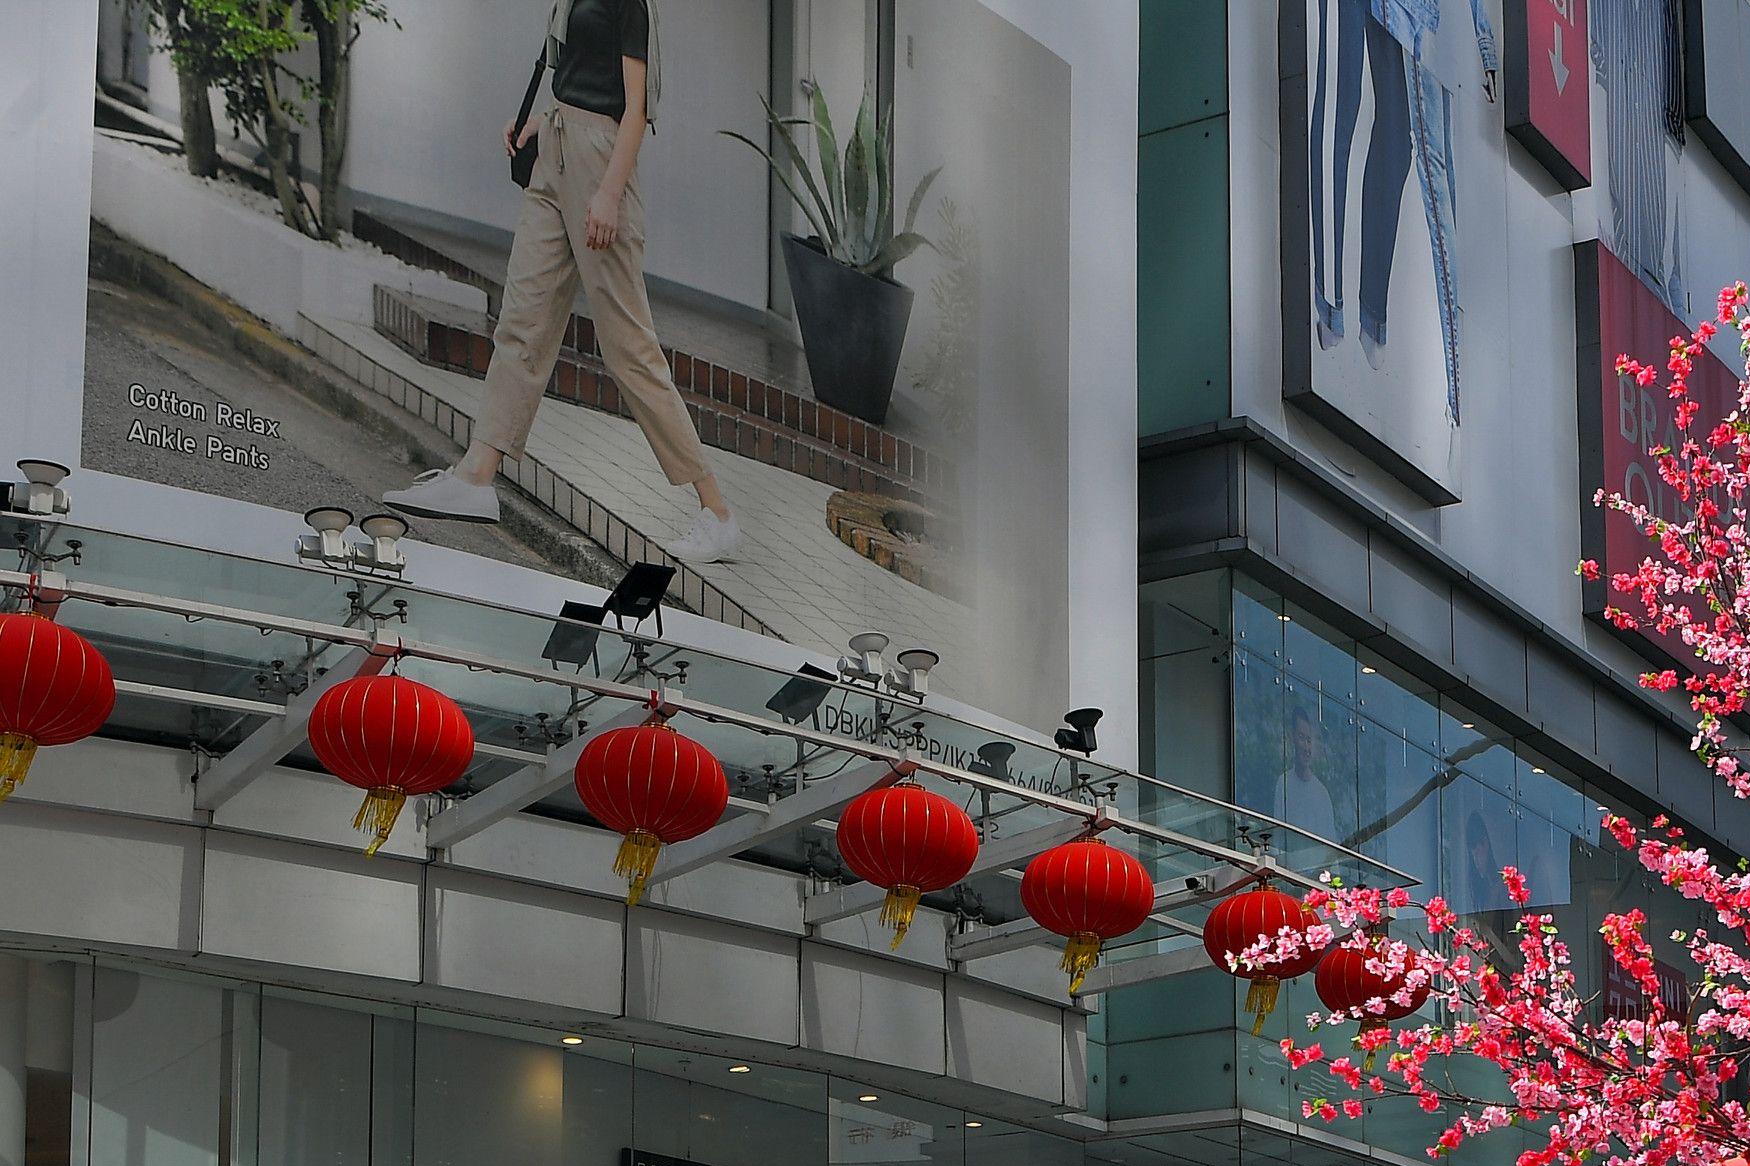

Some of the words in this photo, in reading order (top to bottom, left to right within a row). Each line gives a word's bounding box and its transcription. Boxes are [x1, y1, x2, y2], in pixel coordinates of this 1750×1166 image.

[128, 383, 207, 421] Cotton
[216, 401, 281, 438] Relax
[127, 419, 197, 454] Ankle
[206, 435, 270, 470] Pants
